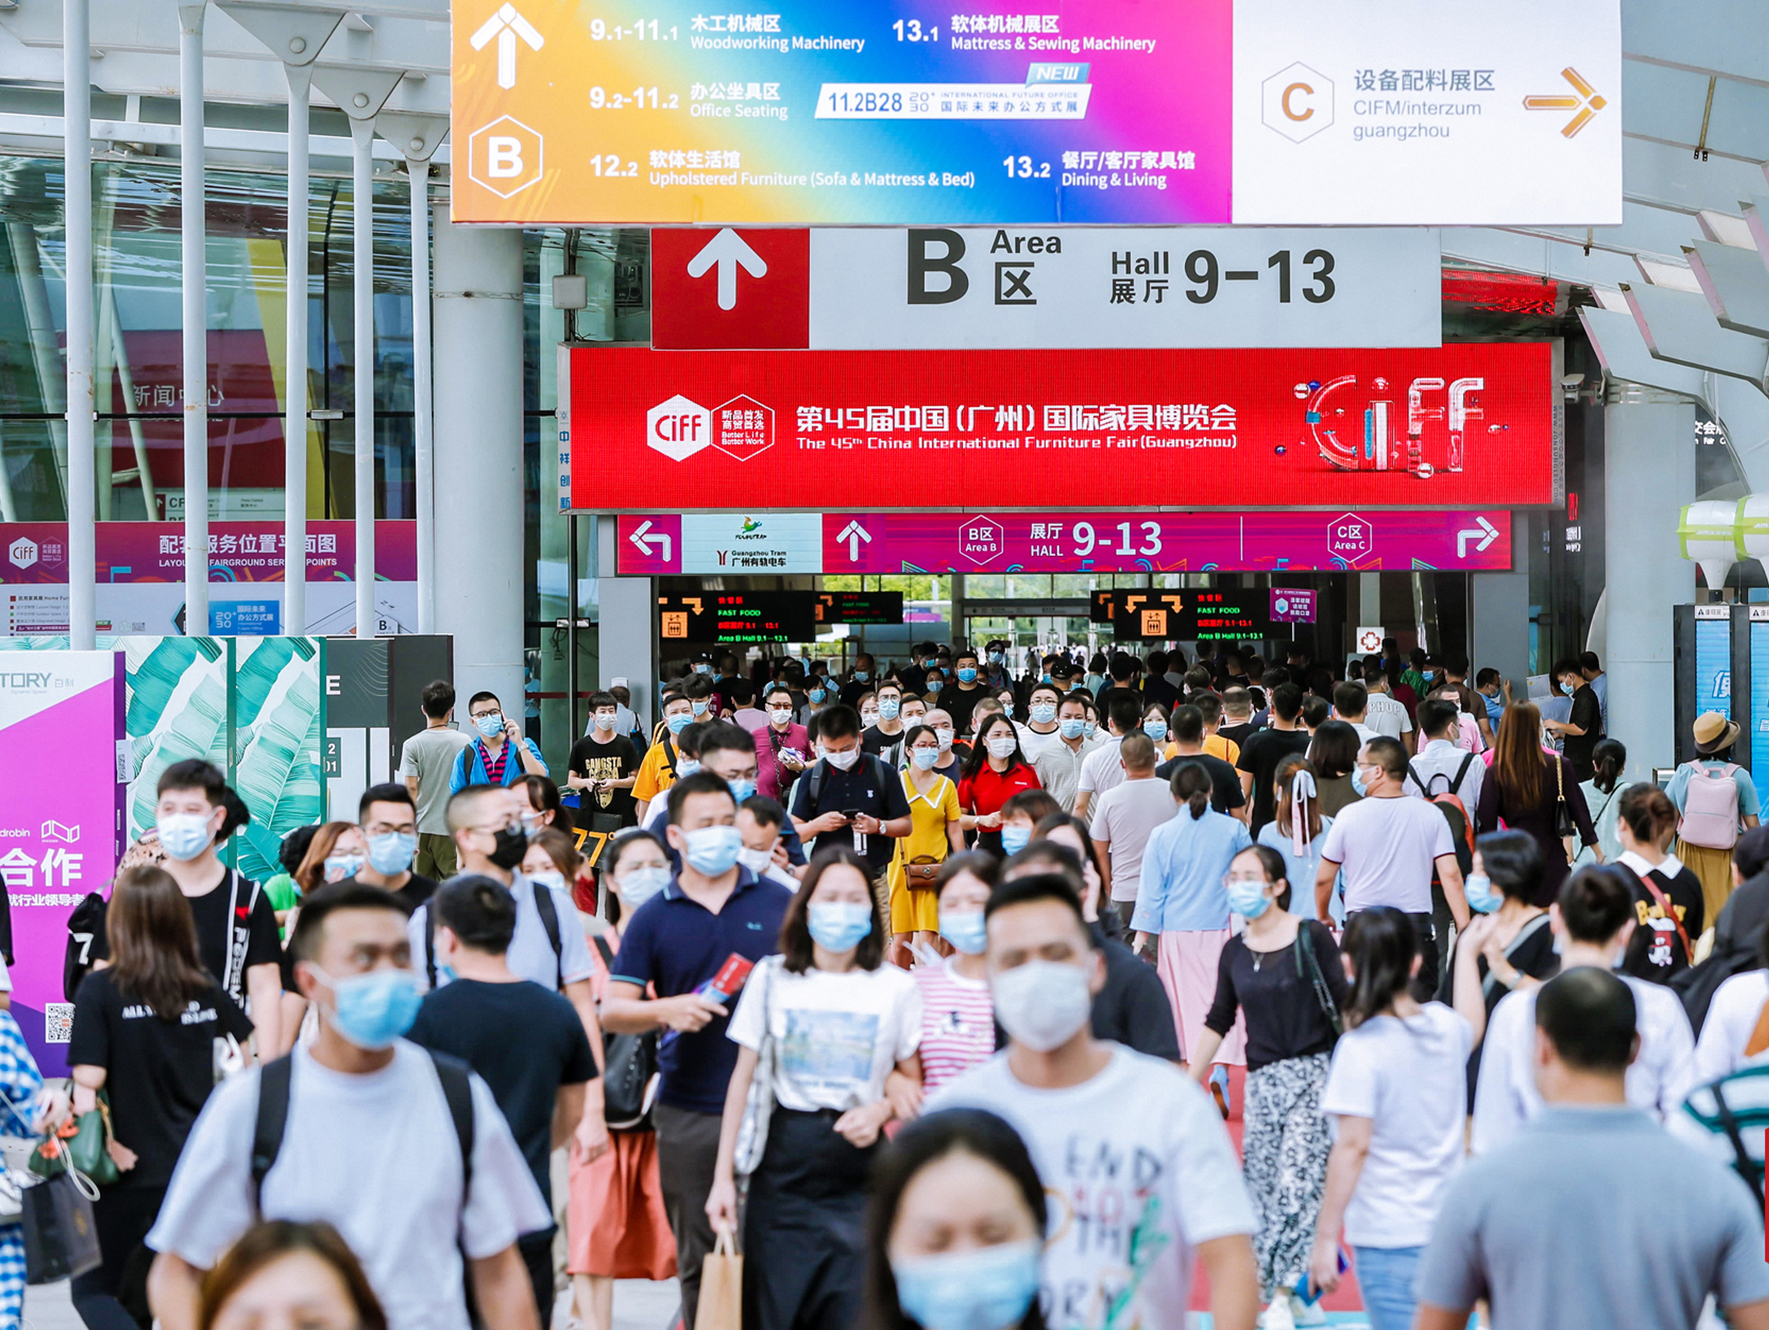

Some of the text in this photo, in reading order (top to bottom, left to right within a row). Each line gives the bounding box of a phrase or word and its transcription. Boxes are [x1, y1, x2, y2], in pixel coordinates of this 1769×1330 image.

[590, 19, 679, 42] 9.1-11.1
[690, 14, 781, 34] 木工机械区
[892, 19, 938, 42] 13.1
[950, 14, 1060, 35] 软体机械展区
[690, 36, 866, 54] Woodworking Machinery
[951, 36, 1156, 54] Mattress & Sewing Machinery
[1036, 65, 1080, 81] NEW
[1353, 68, 1496, 93] 设备配料展区
[590, 86, 679, 110] 9.2-11.2
[690, 83, 781, 103] 办公坐具区
[827, 91, 903, 112] 11.2B28
[1281, 82, 1315, 123] C
[690, 104, 788, 121] Office Seating
[940, 101, 1079, 113] 国际未来办公方式展
[1353, 100, 1482, 117] CIFM/interzum
[1353, 122, 1451, 142] guangzhou
[488, 136, 525, 179] B
[589, 154, 639, 178] 12.2
[649, 150, 741, 170] 软体生活馆
[1002, 155, 1051, 179] 13.2
[1062, 152, 1197, 171] 餐厅/客厅家具馆
[649, 171, 975, 188] Upholstered Furniture (Sofa & Mattress & Bed)
[1063, 172, 1168, 190] Dining & Living
[990, 229, 1062, 254] Area
[907, 228, 969, 305] B
[1112, 251, 1170, 275] Hall
[994, 262, 1038, 306] 区
[1110, 279, 1170, 305] 展厅
[133, 384, 225, 407] 新闻心
[800, 436, 826, 450] The
[867, 436, 914, 450] China
[918, 436, 1021, 450] International
[1024, 436, 1102, 449] Furniture
[968, 527, 994, 541] B区
[1030, 523, 1064, 540] 展厅
[1072, 520, 1163, 557] 9-13
[1337, 524, 1362, 539] C区
[965, 542, 997, 552] Area B
[1030, 545, 1064, 557] HALL
[1334, 541, 1366, 550] Area C
[209, 558, 266, 568] FAIRGROUND
[306, 557, 338, 566] POINTS
[237, 613, 274, 622] 办公方式展
[718, 609, 761, 617] FAST FOOD
[1197, 632, 1214, 640] Area
[1221, 632, 1235, 640] Hall
[585, 756, 623, 771] GANGSTA
